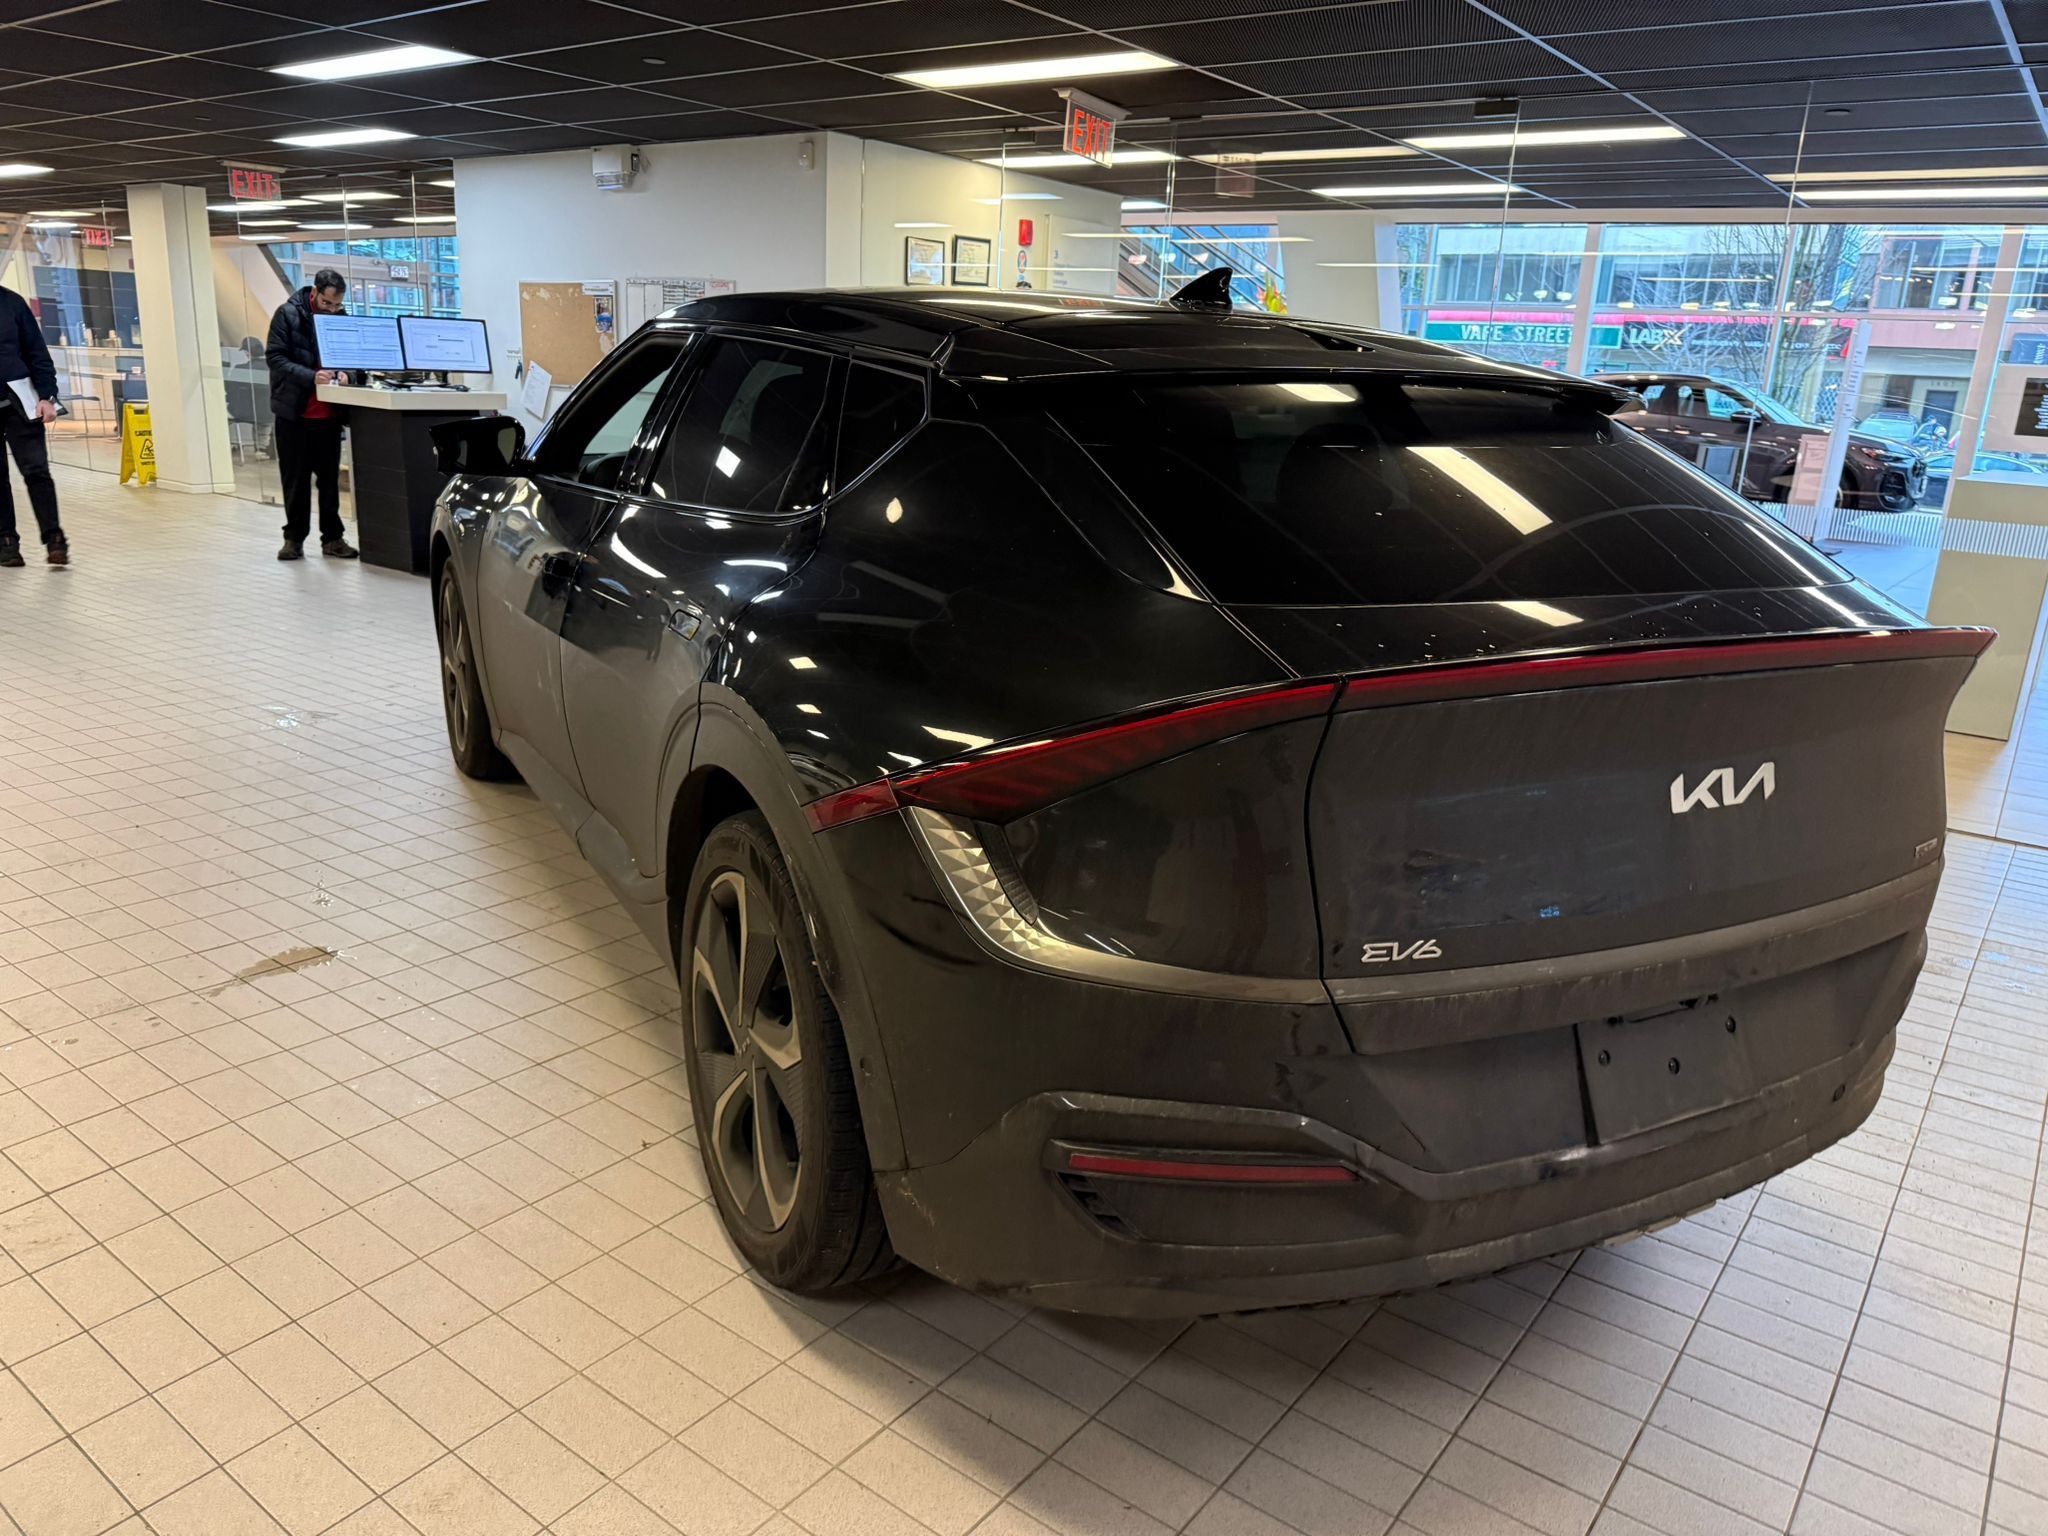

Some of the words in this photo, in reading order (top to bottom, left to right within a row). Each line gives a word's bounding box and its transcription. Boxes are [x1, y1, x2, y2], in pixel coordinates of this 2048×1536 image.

[1072, 108, 1112, 163] EXIT
[232, 169, 273, 200] EXIT
[1460, 323, 1502, 342] VAPE
[1670, 761, 1776, 814] KIA
[1361, 939, 1442, 963] EV6
